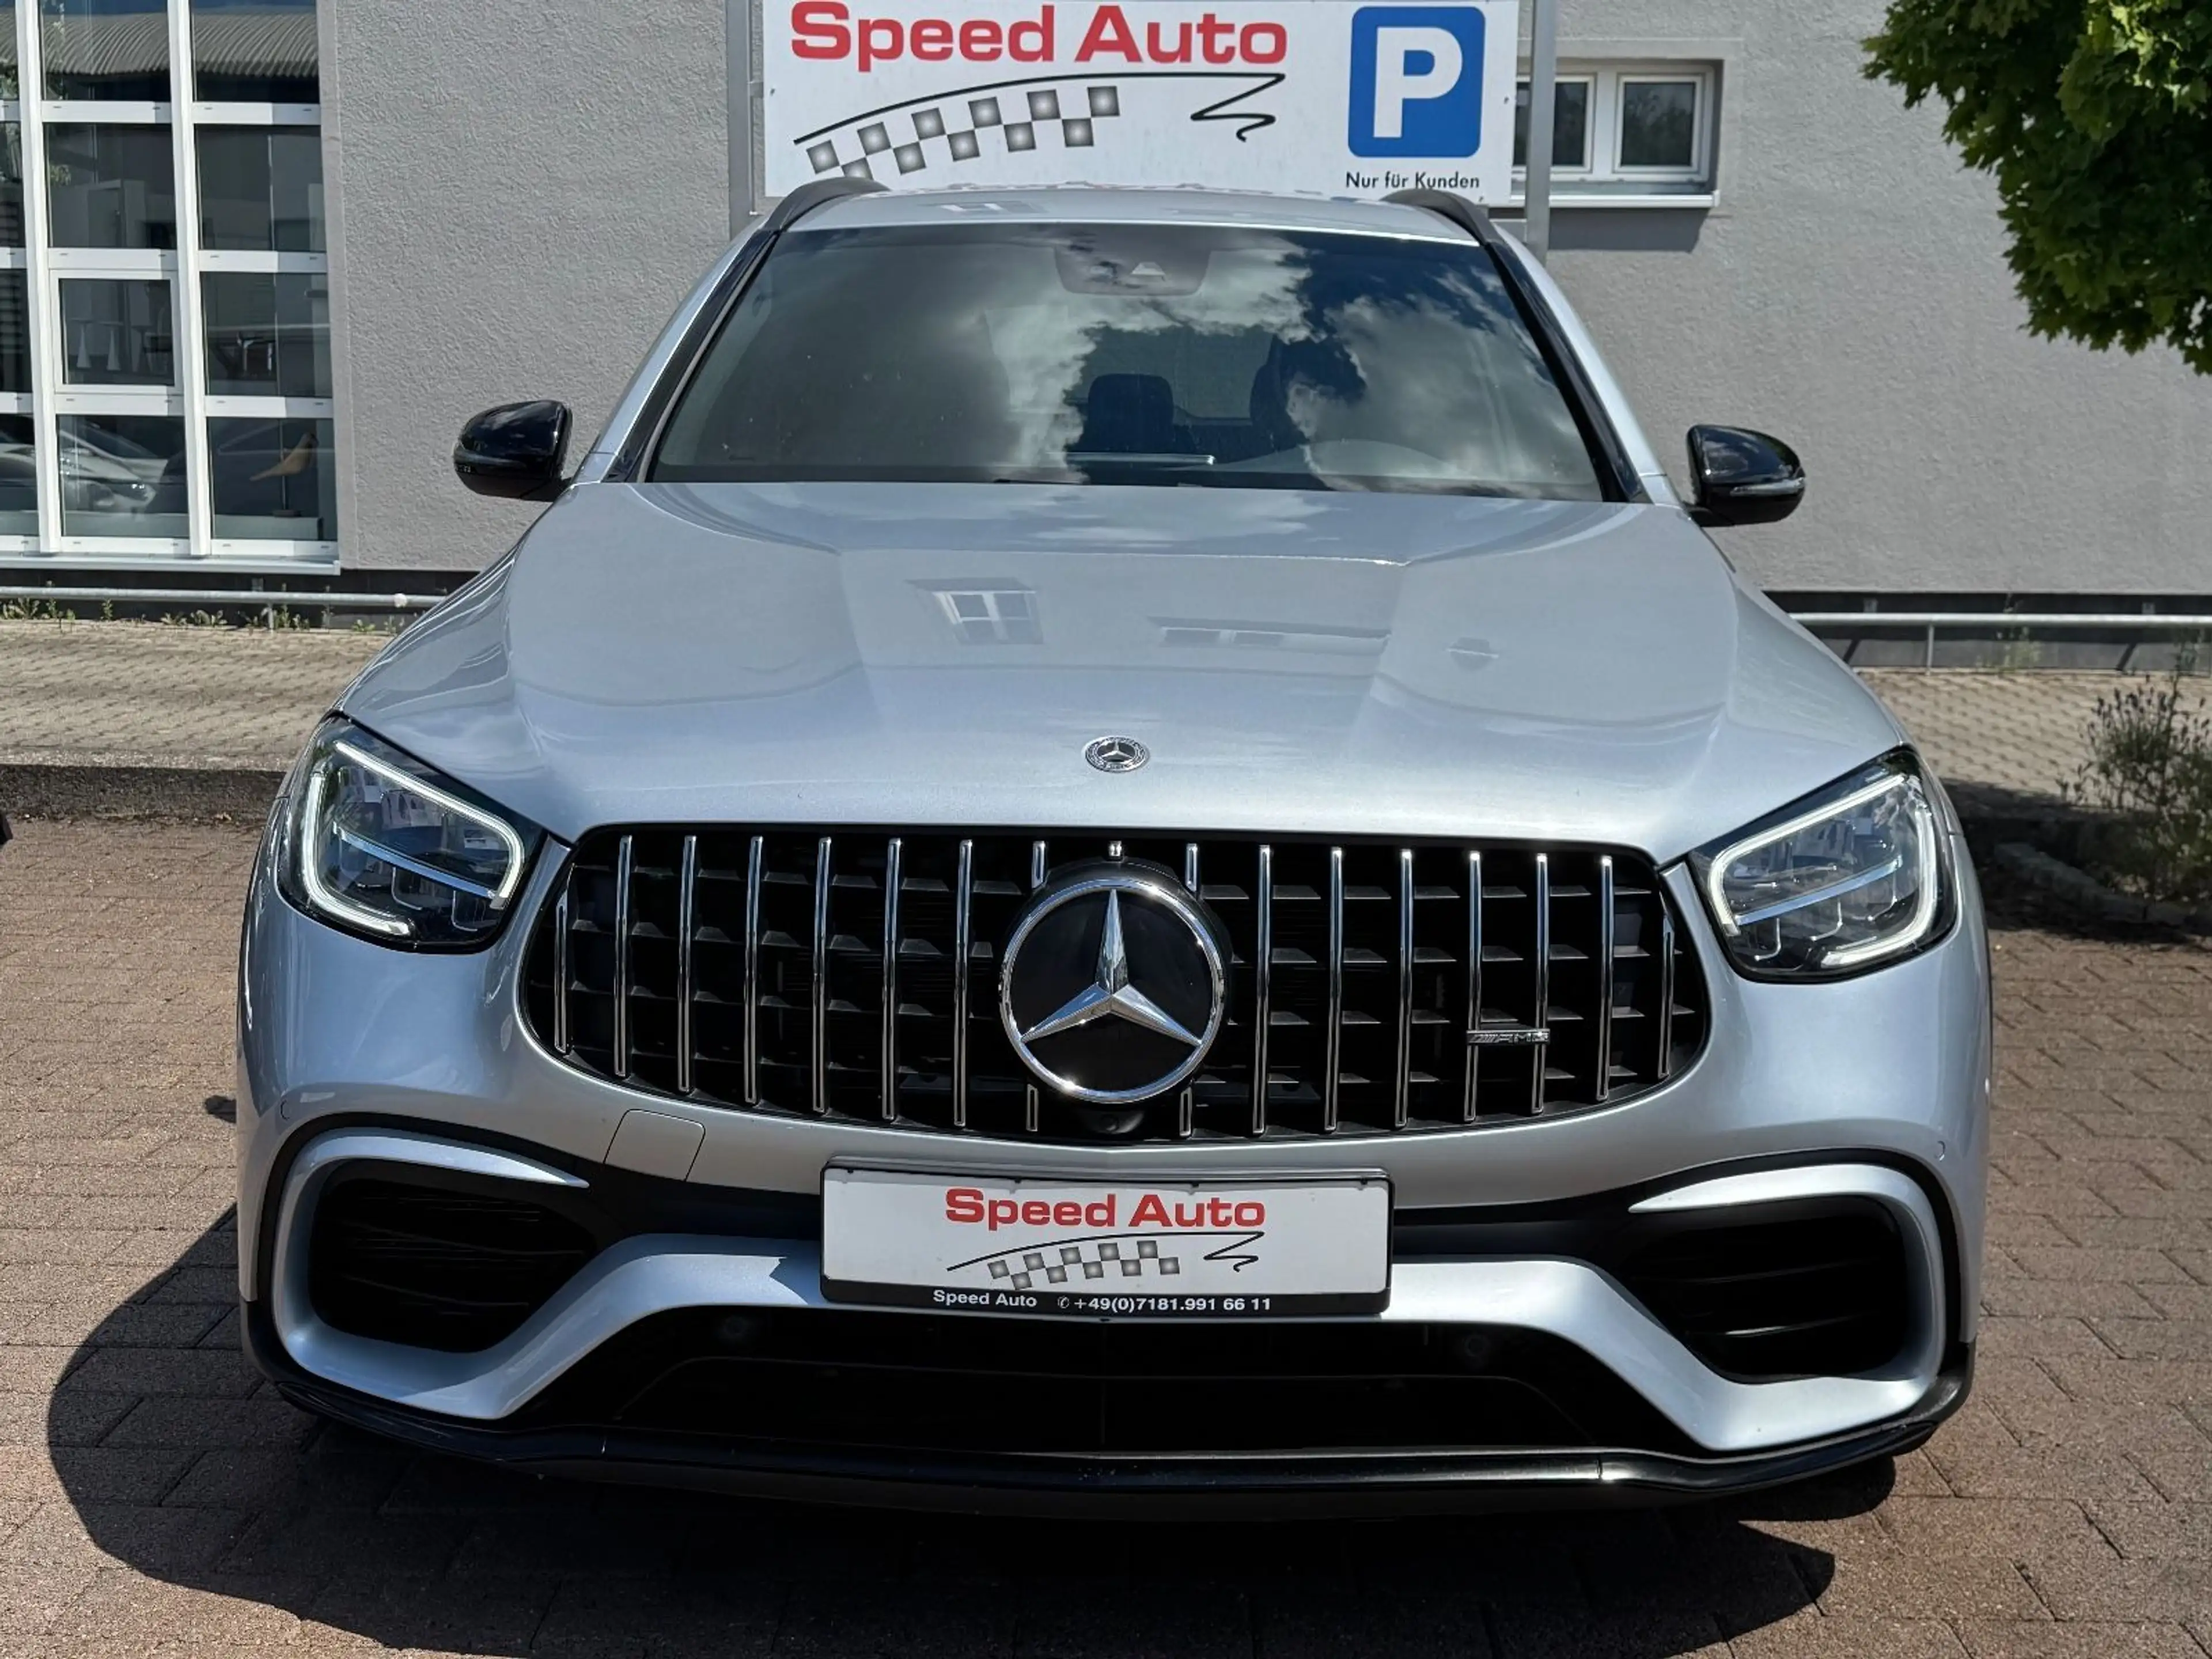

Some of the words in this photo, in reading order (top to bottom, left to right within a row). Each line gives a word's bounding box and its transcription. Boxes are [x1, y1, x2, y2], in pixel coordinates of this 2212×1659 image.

[791, 0, 1055, 73] Speed
[1074, 4, 1288, 65] Auto
[1373, 26, 1463, 138] P
[1346, 171, 1379, 189] Nur
[1384, 171, 1409, 189] für
[1415, 171, 1480, 190] Kunden
[945, 1188, 1116, 1230] Speed
[1128, 1194, 1266, 1228] Auto
[933, 1289, 990, 1306] Speed
[995, 1293, 1037, 1308] Auto
[1074, 1297, 1215, 1313] +49(0)7181.991
[1223, 1297, 1245, 1311] 66
[1251, 1297, 1271, 1310] 11
